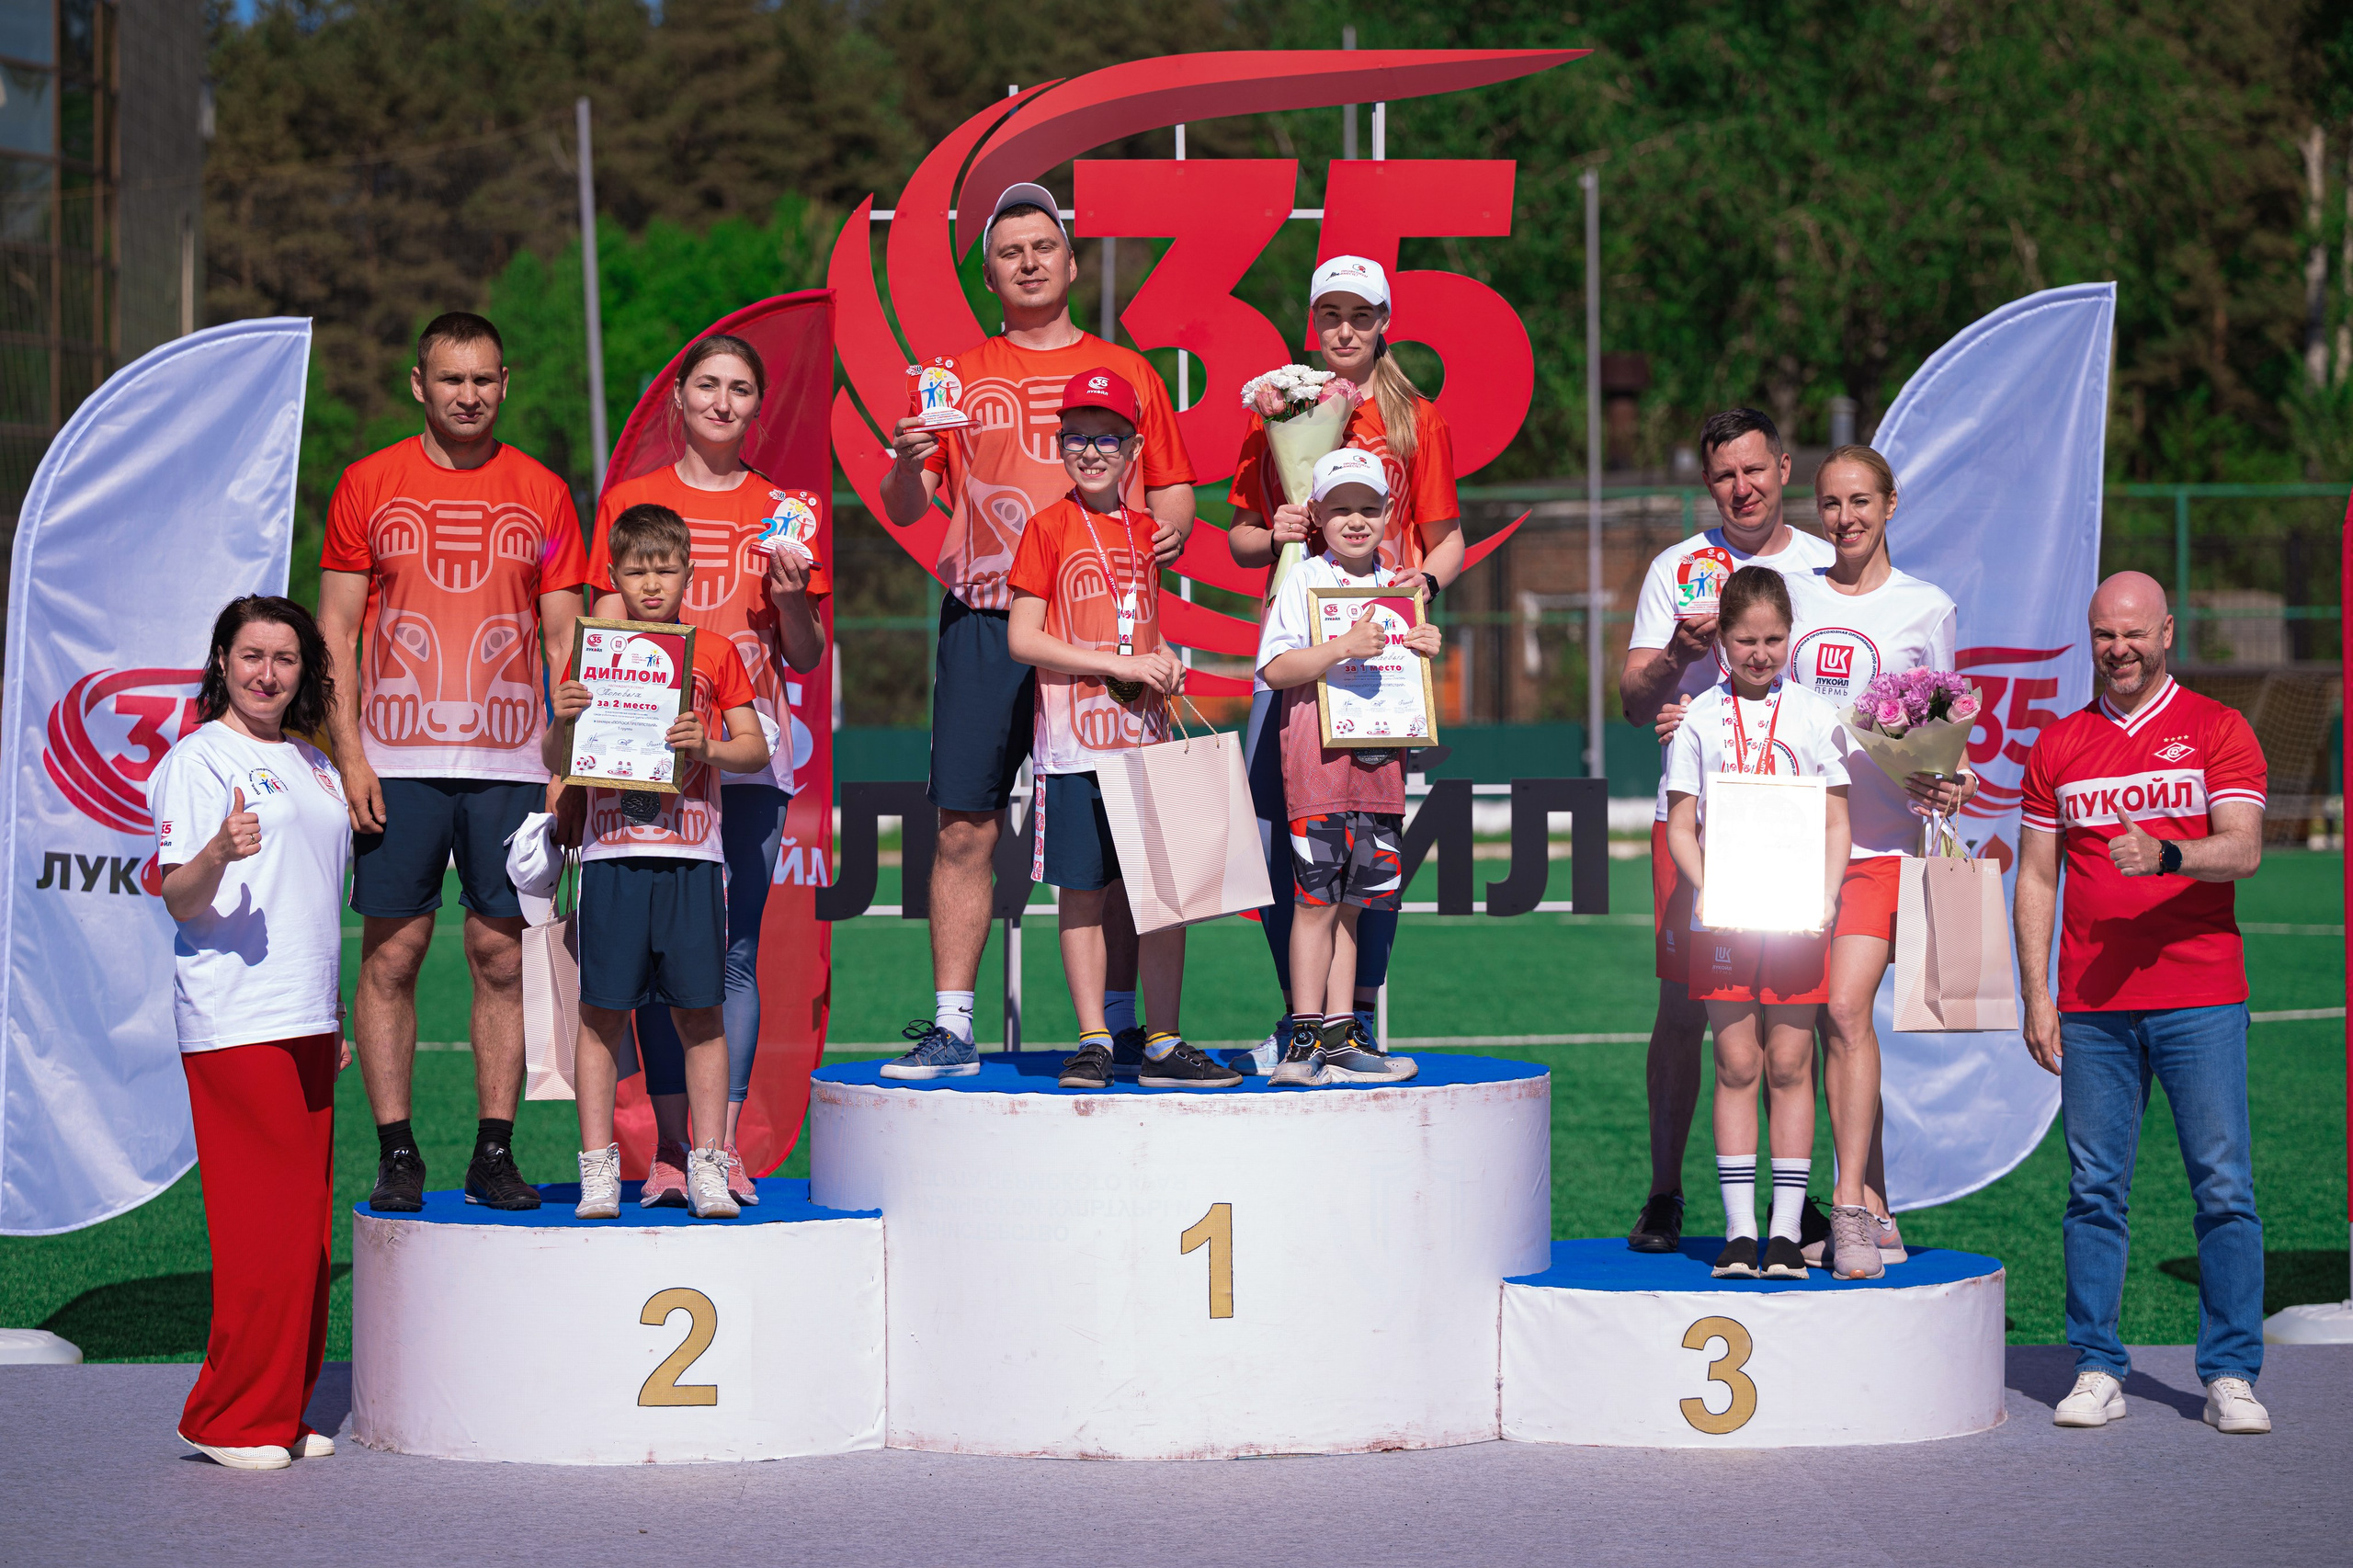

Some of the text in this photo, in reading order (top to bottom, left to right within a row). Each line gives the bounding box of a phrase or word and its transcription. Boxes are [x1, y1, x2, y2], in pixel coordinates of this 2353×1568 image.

[1074, 159, 1534, 487] 35
[756, 517, 778, 541] 2
[1677, 584, 1695, 607] 3
[583, 666, 667, 684] ДИПЛОМ
[1359, 664, 1366, 672] 1
[1813, 687, 1848, 697] ПЕРМЬ
[1814, 677, 1849, 687] ЛУКОЙЛ
[597, 699, 658, 710] за 2 место
[2064, 778, 2193, 822] ЛУКОЙЛ
[1180, 1202, 1233, 1319] 1
[638, 1288, 718, 1407] 2
[1679, 1315, 1757, 1434] 3
